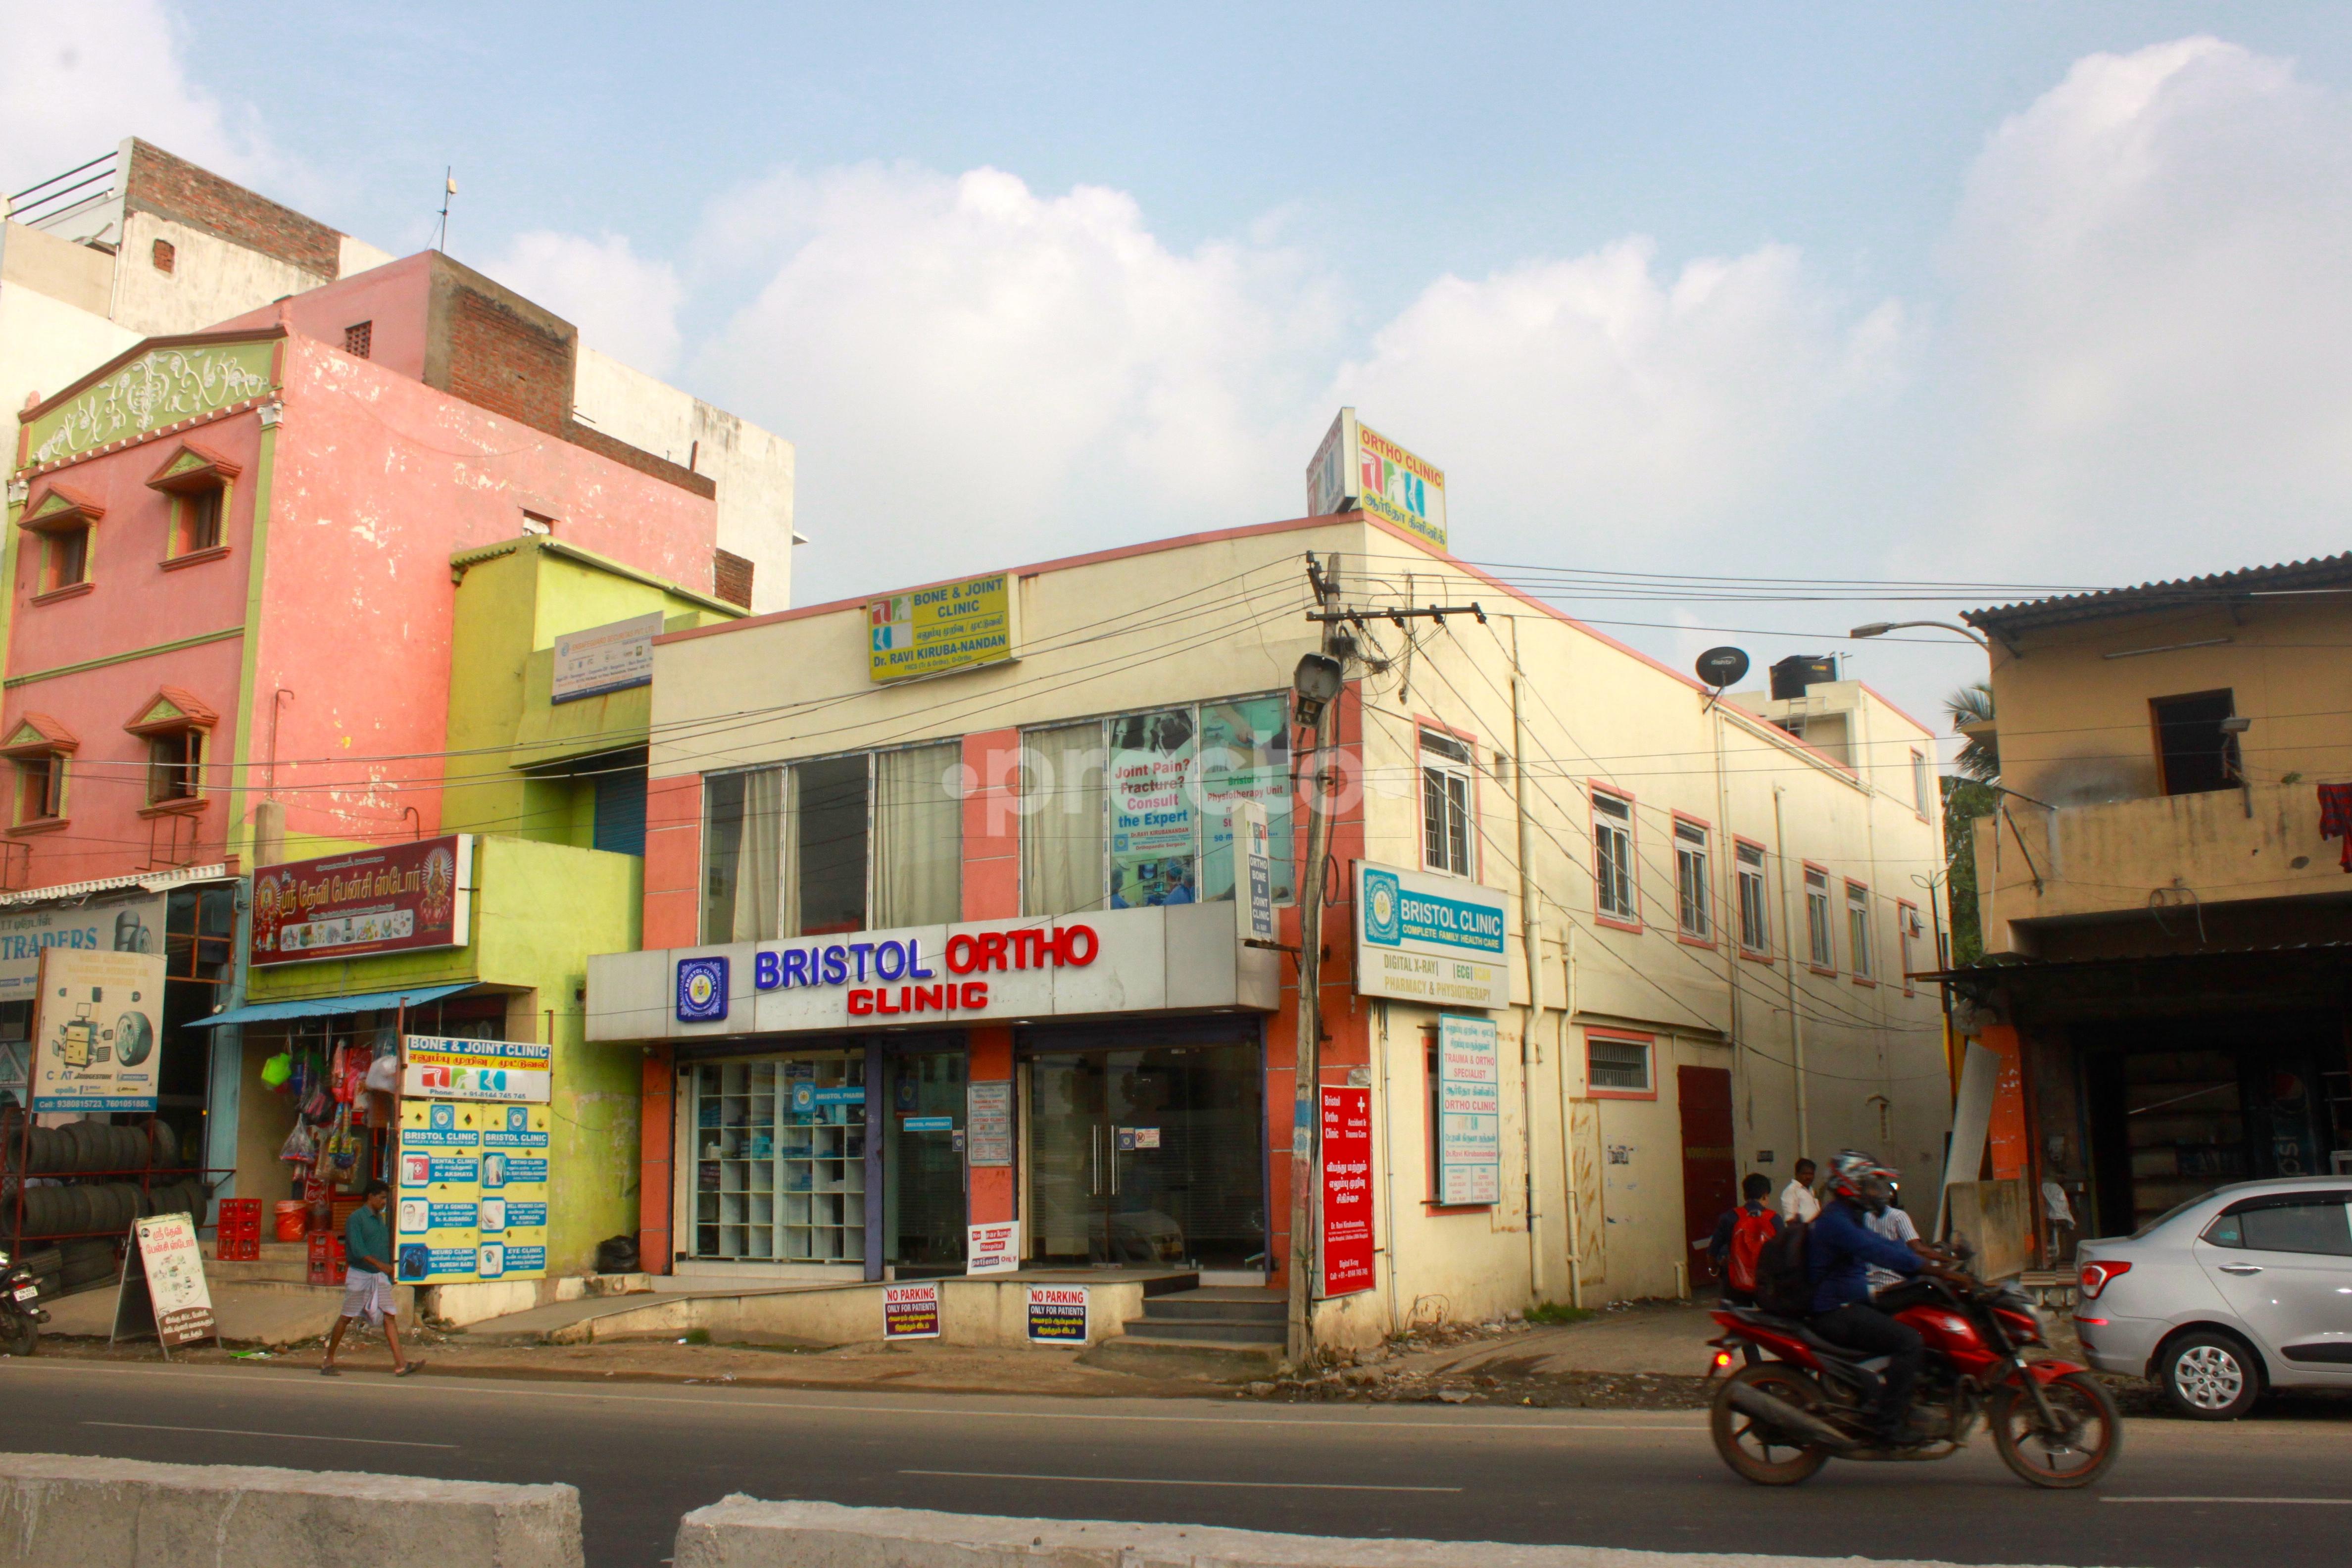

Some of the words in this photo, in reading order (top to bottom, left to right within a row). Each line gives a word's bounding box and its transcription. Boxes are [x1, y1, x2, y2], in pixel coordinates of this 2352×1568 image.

[1362, 430, 1402, 464] ORTHO
[1406, 455, 1442, 487] CLINIC
[914, 589, 947, 606] BONE
[952, 587, 961, 598] &
[966, 578, 1003, 596] JOINT
[938, 600, 980, 618] CLINIC
[874, 656, 886, 667] Dr.
[890, 650, 913, 664] RAVI
[917, 635, 1006, 659] KIRUBA-NANDAN
[1115, 764, 1148, 779] Joint
[1153, 758, 1190, 775] Pain?
[1121, 776, 1184, 794] Fracture?
[1208, 789, 1264, 803] Physiotherapy
[1266, 785, 1283, 795] Unit
[1127, 794, 1179, 810] Consult
[1119, 815, 1139, 828] the
[1145, 809, 1188, 827] Expert
[1250, 857, 1267, 870] ORTHO
[1252, 870, 1266, 882] BONE
[299, 878, 329, 913] தேவி
[332, 871, 372, 903] பேன்சி
[375, 863, 421, 896] ஸ்டோர்
[1258, 884, 1262, 893] &
[1253, 897, 1268, 907] JOINT
[1253, 909, 1270, 921] CLINIC
[1400, 899, 1458, 929] BRISTOL
[1460, 910, 1501, 936] CLINIC
[1, 927, 98, 960] TRADERS
[1402, 924, 1436, 938] COMPLETE
[1439, 930, 1459, 942] FAMILY
[1461, 934, 1482, 945] HEALTH
[1483, 938, 1499, 949] CARE
[755, 938, 937, 990] BRISTOL
[945, 924, 1099, 975] ORTHO
[1384, 954, 1413, 972] DIGITAL
[1457, 965, 1470, 980] ECG
[686, 968, 703, 987] BRISTOL
[703, 969, 717, 985] CLINIC
[1385, 976, 1426, 995] PHARMACY
[1429, 981, 1435, 995] &
[1436, 982, 1491, 1002] PHYSIOTHERAPY
[848, 981, 988, 1015] CLINIC
[410, 1038, 447, 1050] BONE
[451, 1040, 460, 1051] &
[464, 1041, 505, 1055] JOINT
[506, 1044, 548, 1057] CLINIC
[409, 1053, 449, 1063] எலும்பு
[453, 1056, 488, 1066] முறிவு
[1444, 1053, 1469, 1065] TRAUMA
[1470, 1056, 1474, 1064] &
[1475, 1056, 1495, 1066] ORTHO
[1454, 1068, 1486, 1078] SPECIALIST
[1324, 1095, 1340, 1107] Bristol
[1444, 1100, 1470, 1110] ORTHO
[1472, 1101, 1496, 1111] CLINIC
[1325, 1111, 1339, 1123] Ortho
[1348, 1118, 1363, 1127] Accident
[446, 1132, 478, 1141] CLINIC
[1325, 1127, 1339, 1139] Clinic
[986, 1230, 1011, 1238] parking
[972, 1258, 999, 1267] patients
[887, 1289, 898, 1301] NO
[900, 1287, 934, 1300] PARKING
[1031, 1290, 1043, 1302] NO
[1046, 1290, 1083, 1303] PARKING
[912, 1302, 935, 1312] PATIENTS
[1030, 1305, 1045, 1314] ONLY
[1046, 1306, 1057, 1315] FOR
[1058, 1307, 1084, 1316] PATIENTS
